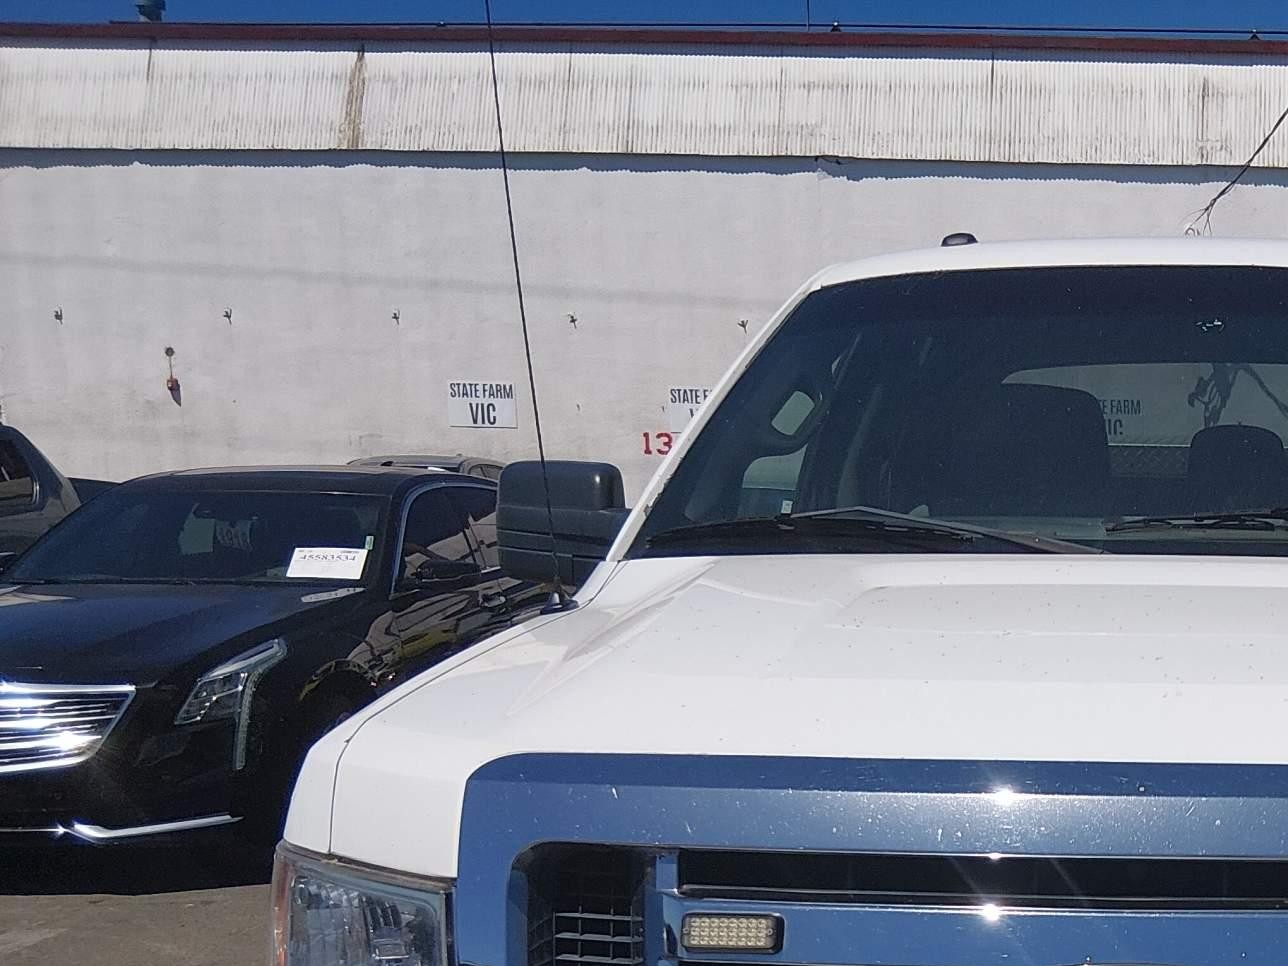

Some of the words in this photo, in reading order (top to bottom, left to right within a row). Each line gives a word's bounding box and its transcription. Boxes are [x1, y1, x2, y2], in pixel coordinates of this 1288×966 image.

[449, 383, 480, 399] STATE
[482, 383, 514, 400] FARM
[670, 388, 701, 405] STATE
[469, 402, 497, 426] VIC
[1110, 399, 1141, 415] FARM
[1107, 419, 1123, 435] IC
[642, 432, 673, 456] 13
